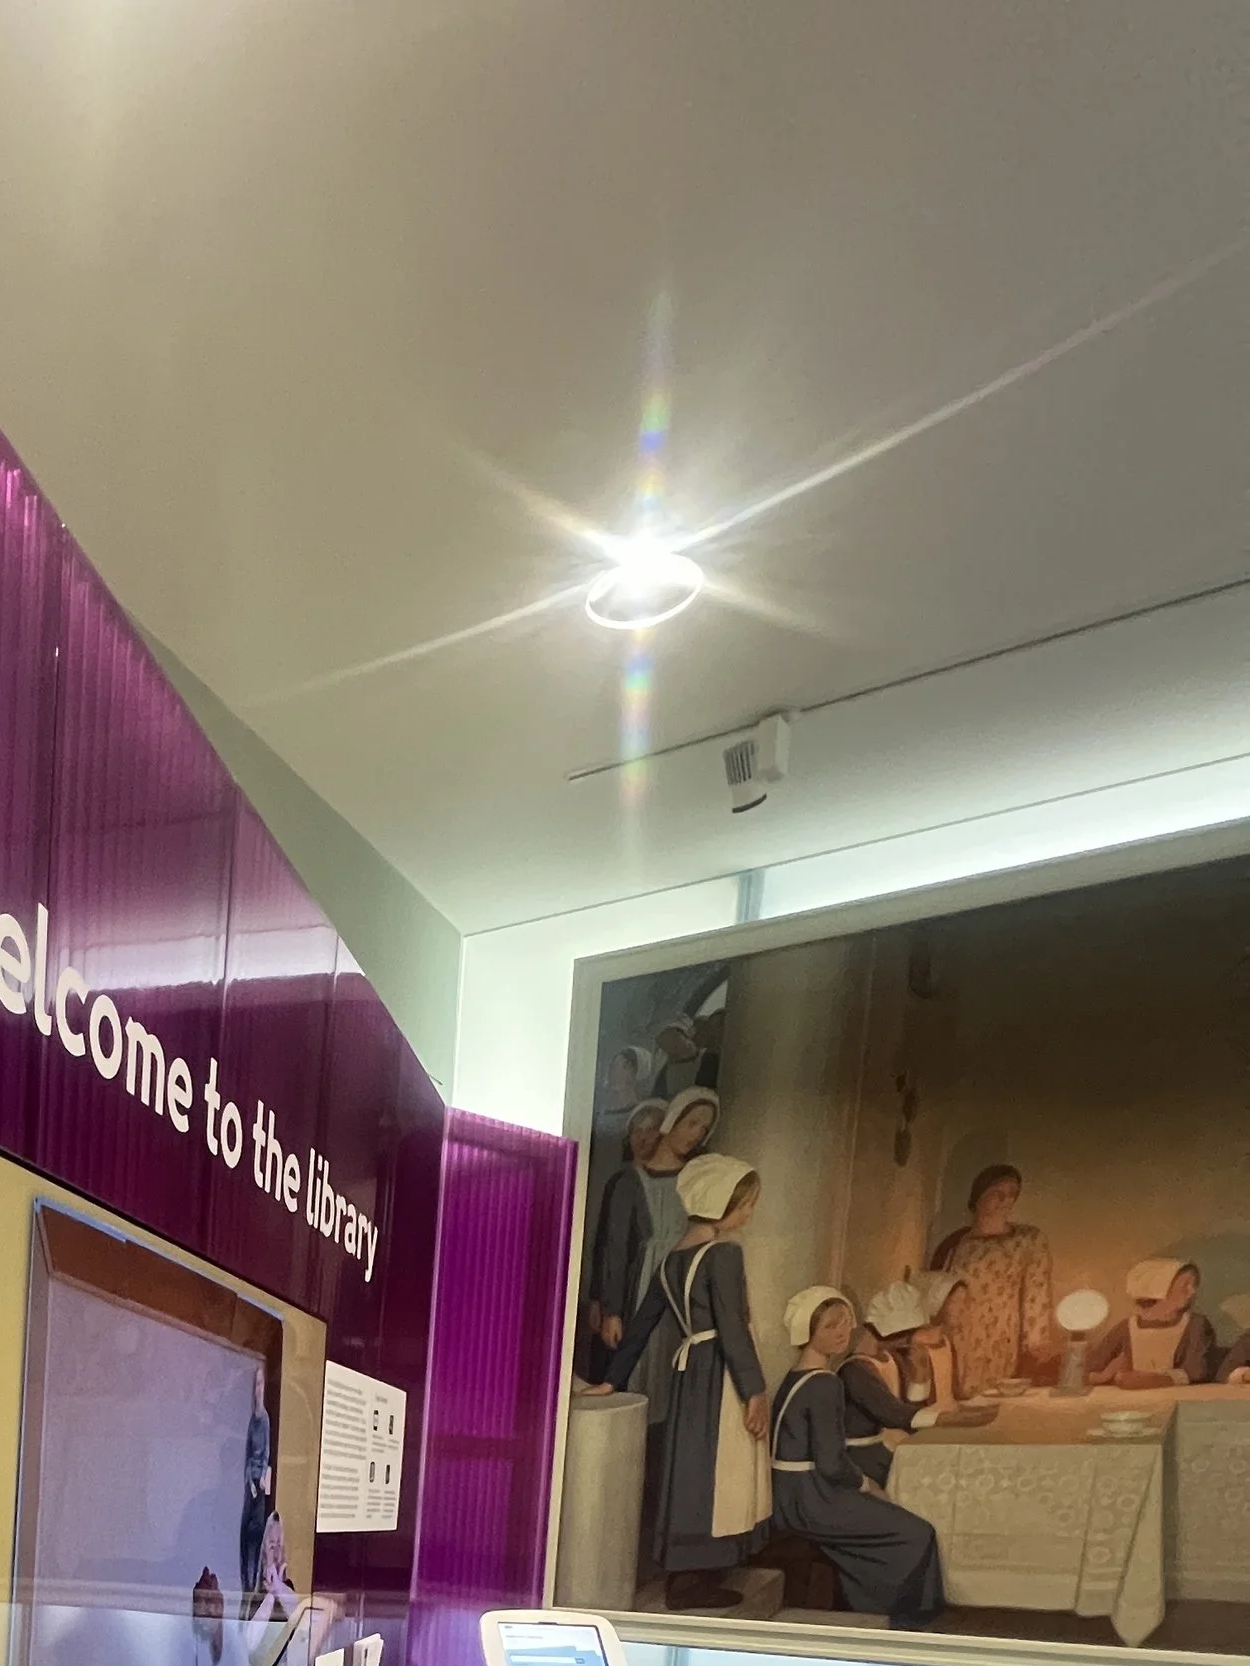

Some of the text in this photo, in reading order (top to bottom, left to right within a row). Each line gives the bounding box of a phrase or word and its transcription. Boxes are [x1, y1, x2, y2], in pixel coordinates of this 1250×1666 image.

[205, 1057, 242, 1169] to
[253, 1099, 299, 1213] the
[306, 1147, 378, 1283] library
